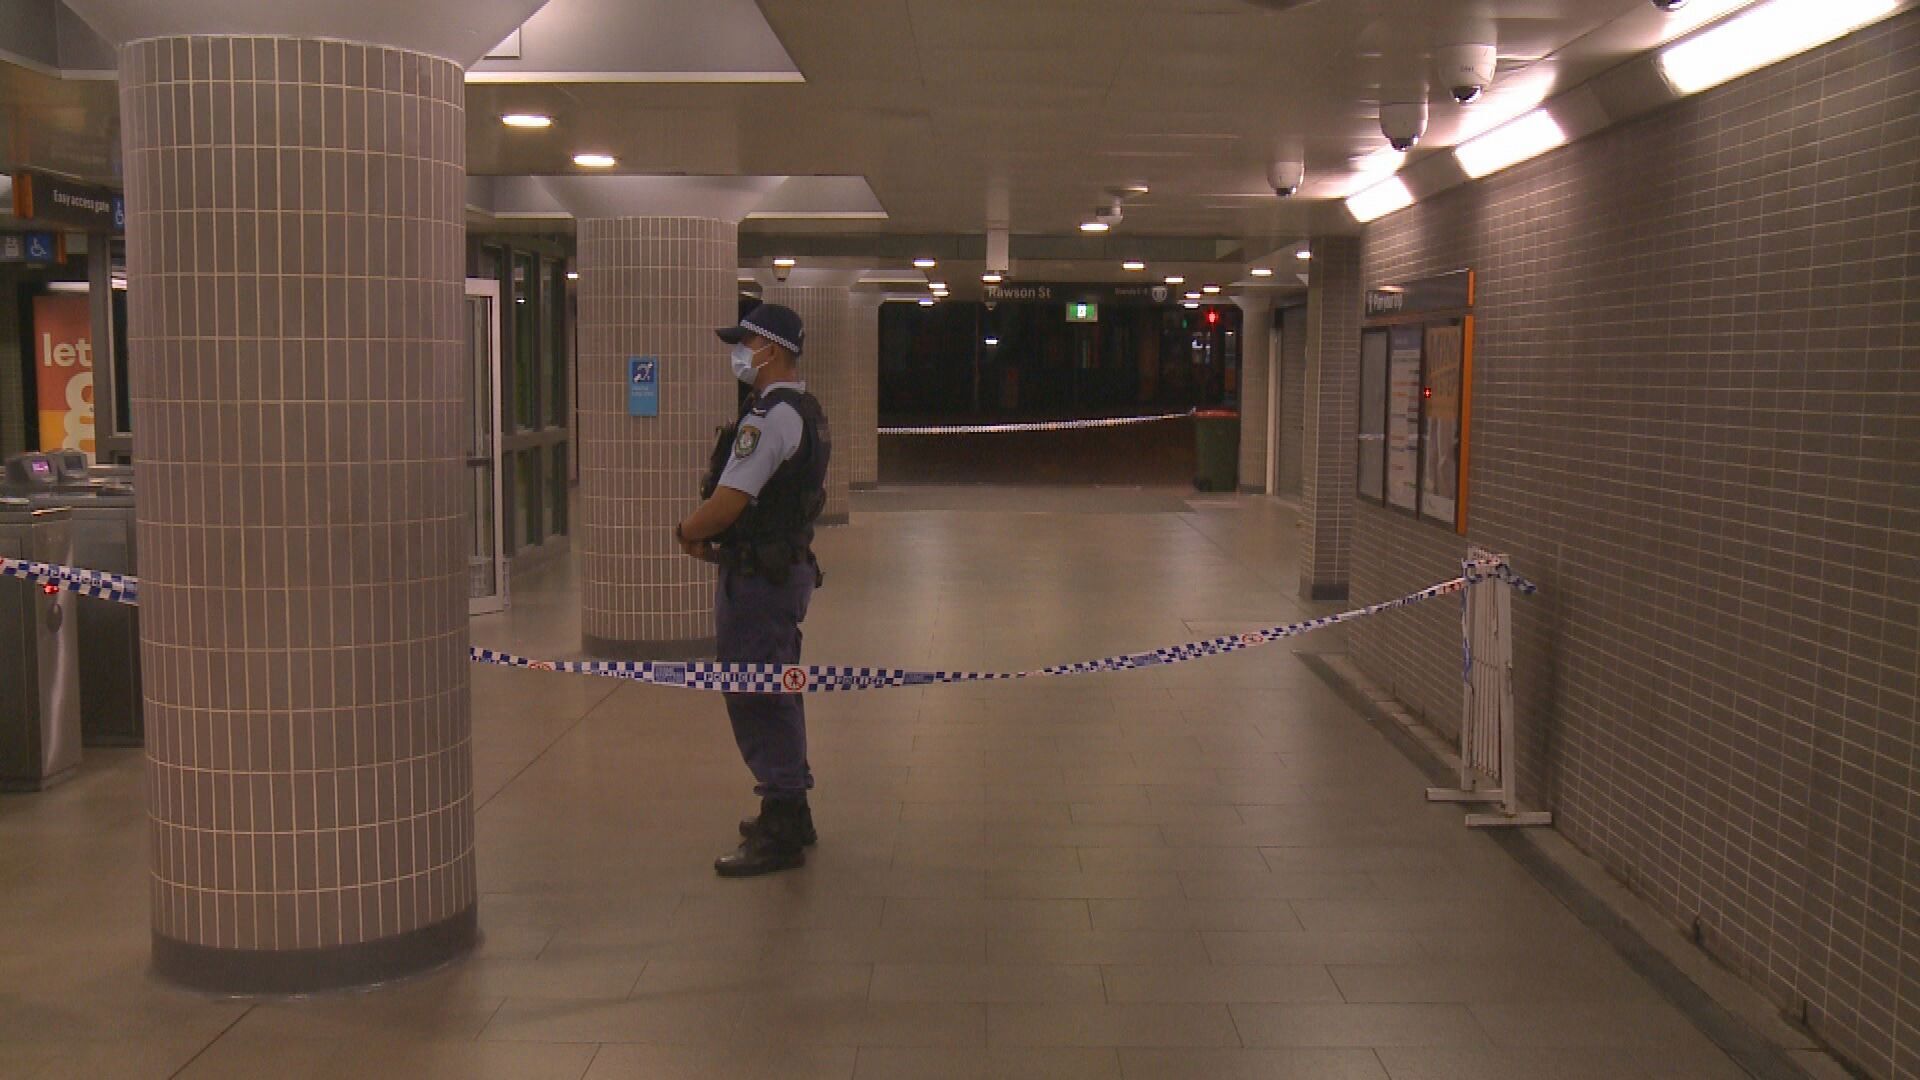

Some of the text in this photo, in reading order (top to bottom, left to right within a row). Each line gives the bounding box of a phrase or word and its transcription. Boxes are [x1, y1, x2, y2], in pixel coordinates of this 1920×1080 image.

[53, 190, 70, 206] Easy
[71, 196, 94, 209] access
[988, 286, 1052, 298] Rawson St
[705, 672, 756, 683] POLICE
